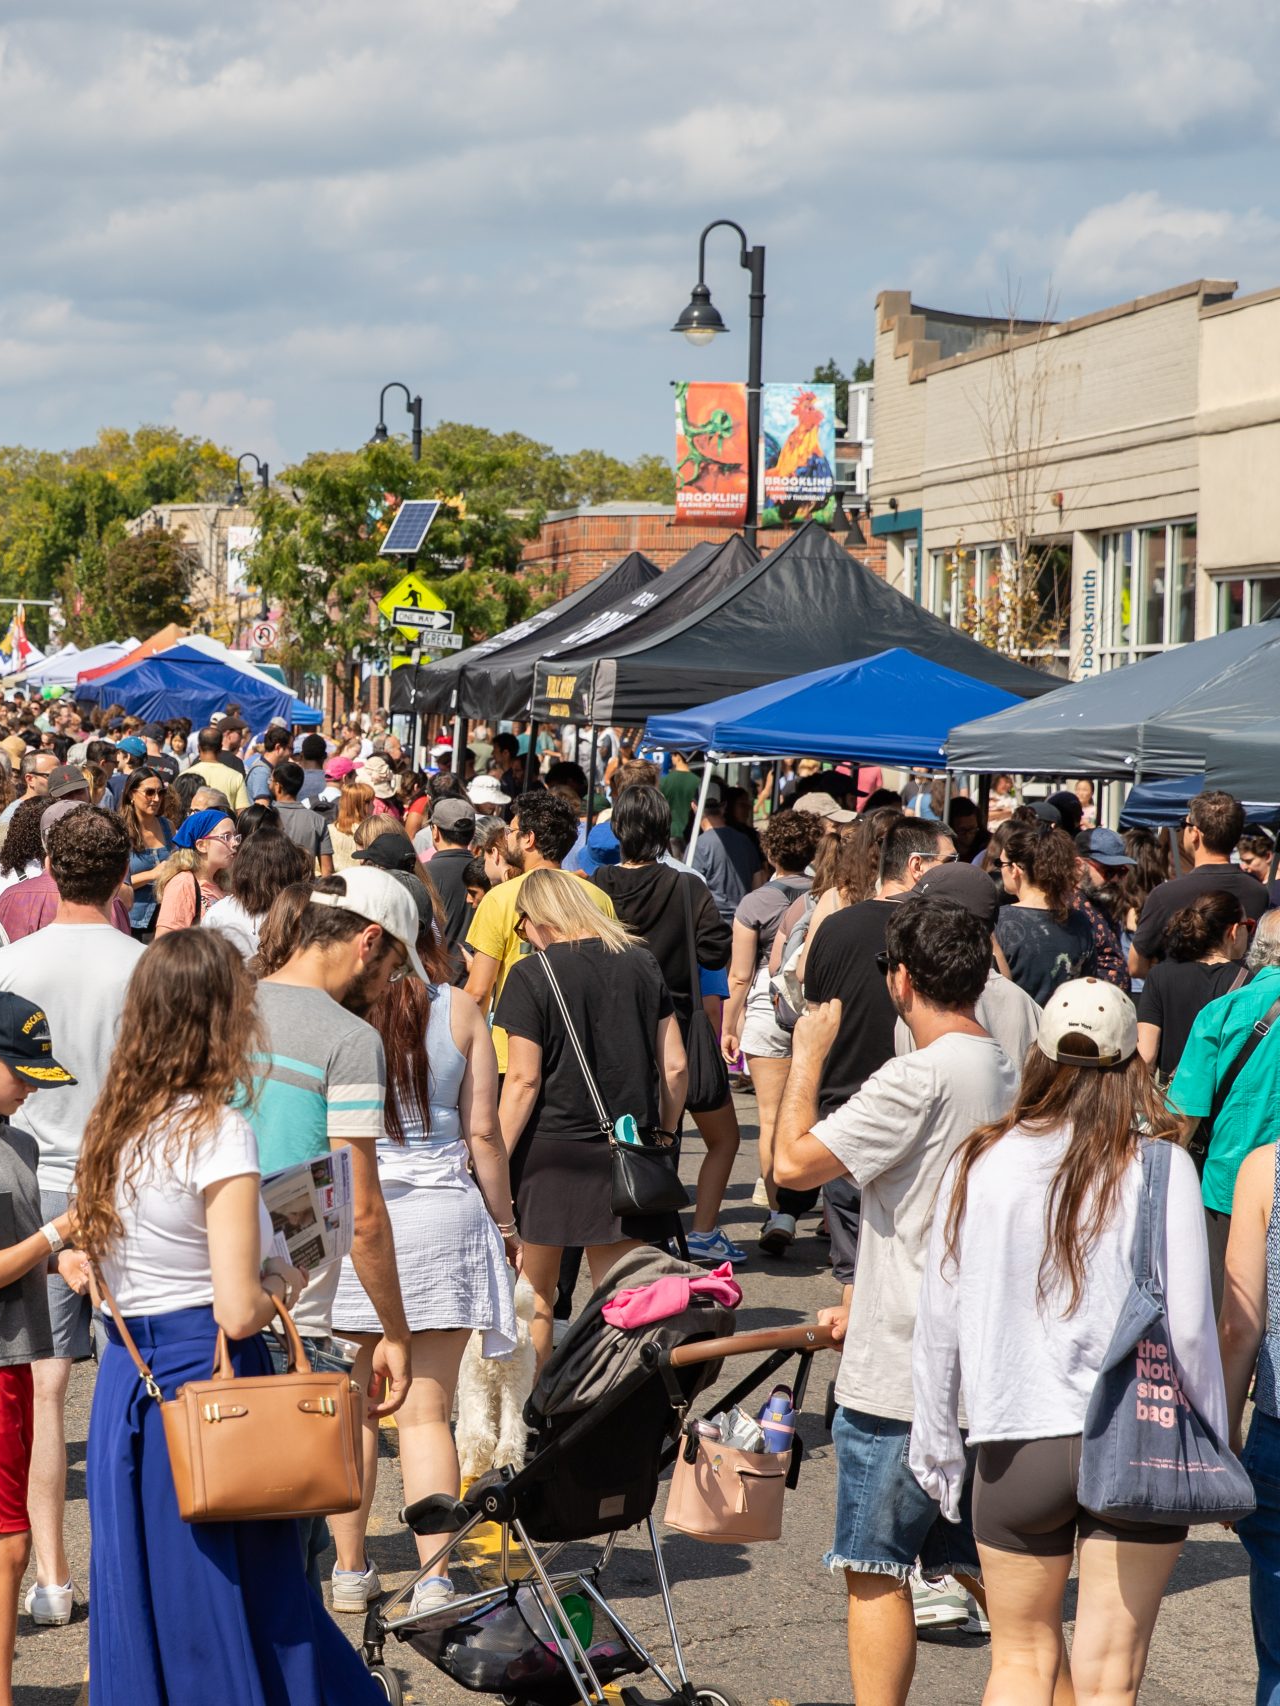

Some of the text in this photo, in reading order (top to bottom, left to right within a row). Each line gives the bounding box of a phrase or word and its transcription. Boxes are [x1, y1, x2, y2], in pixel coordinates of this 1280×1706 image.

[765, 477, 833, 487] BROOKLINE
[677, 492, 746, 503] BROOKLINE
[1081, 570, 1096, 668] booksmith
[425, 632, 453, 646] GREEN
[1081, 1022, 1092, 1031] York
[1137, 1338, 1168, 1360] the
